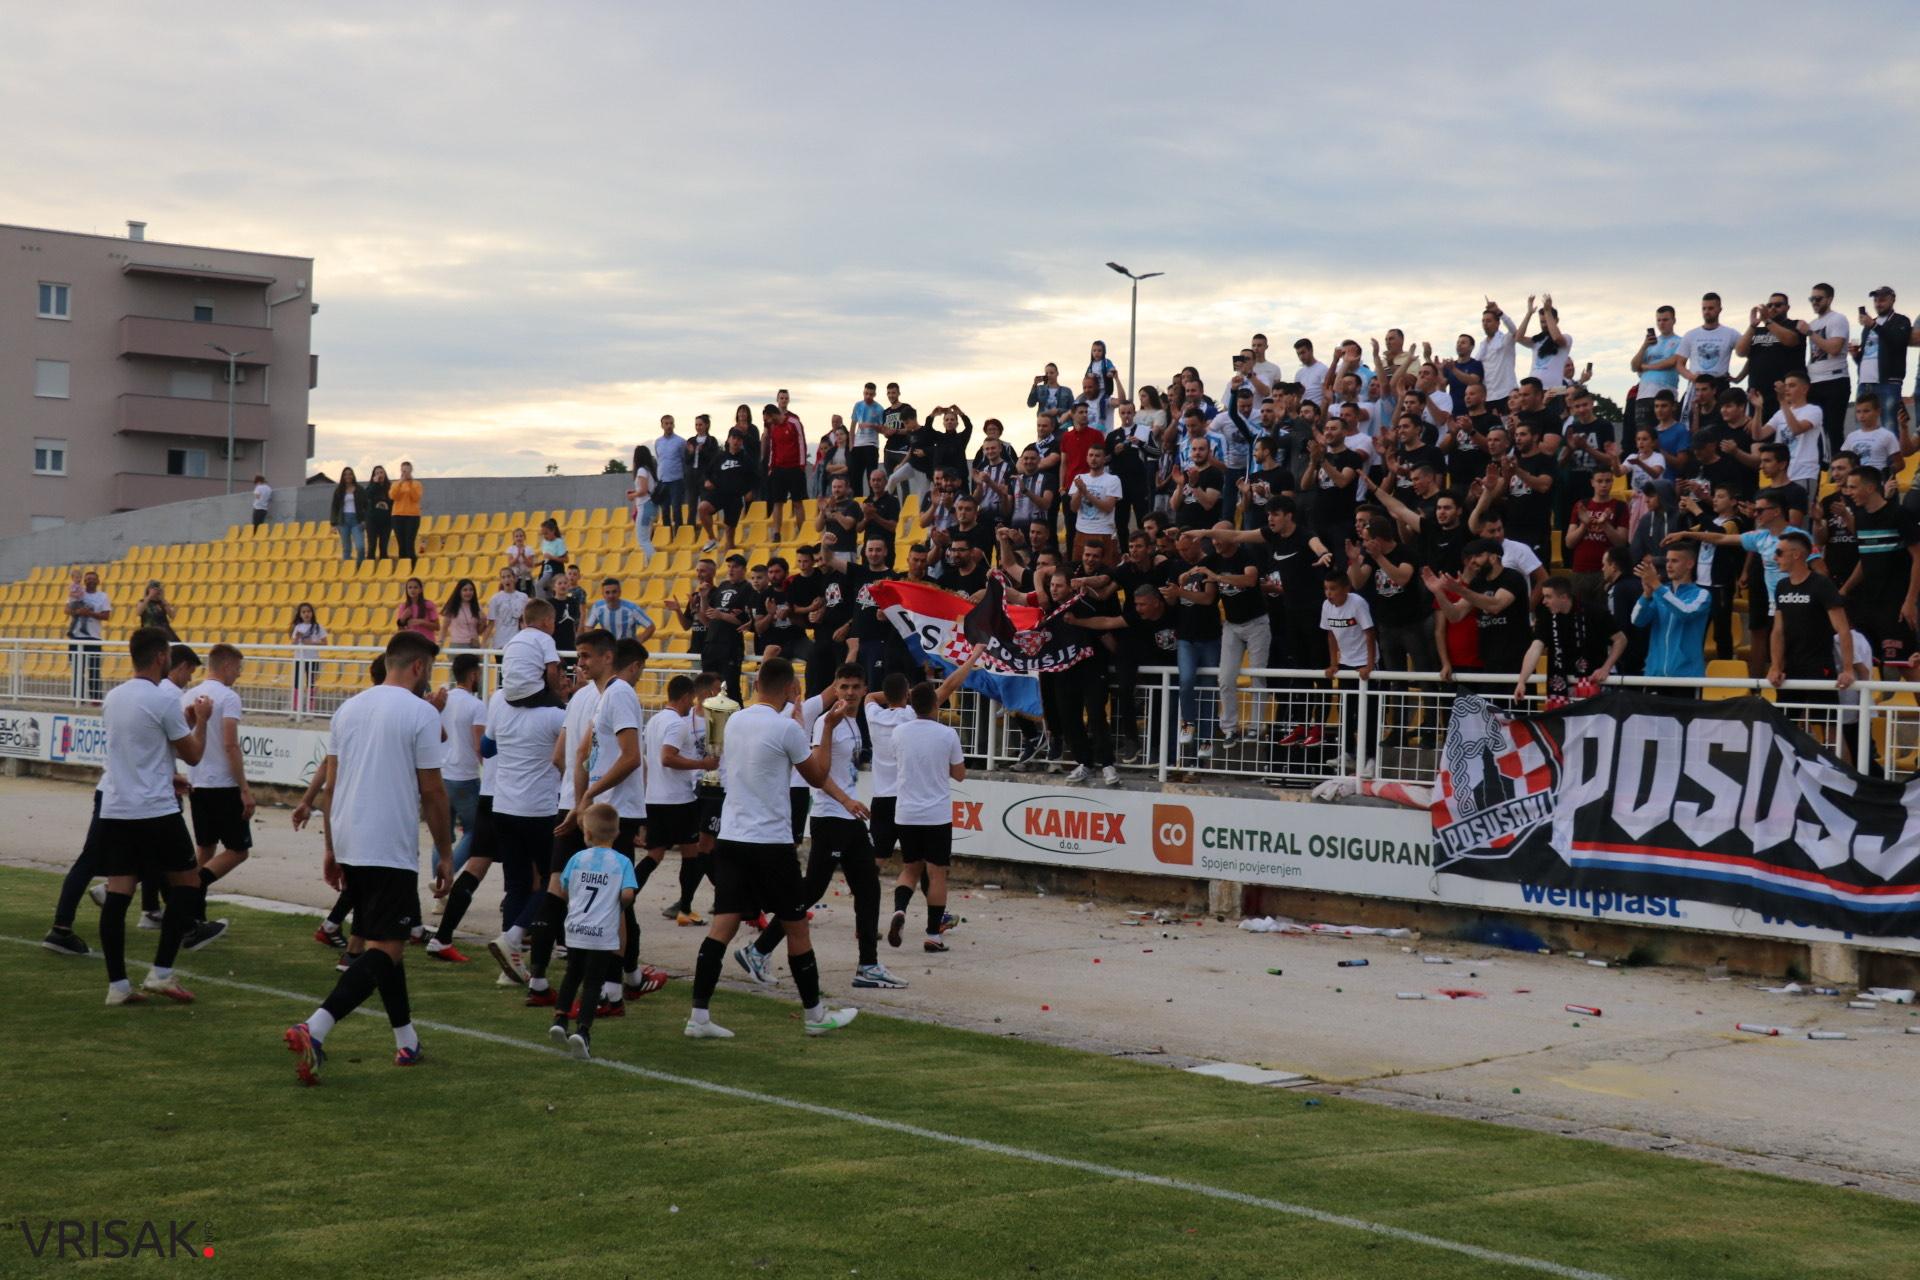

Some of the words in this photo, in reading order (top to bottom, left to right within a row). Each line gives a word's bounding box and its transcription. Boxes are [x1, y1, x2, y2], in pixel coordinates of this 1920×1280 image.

[1778, 592, 1810, 604] adidas
[952, 801, 984, 831] EX
[1025, 807, 1127, 844] KAMEX
[1059, 839, 1081, 851] d.o.o.
[1159, 822, 1187, 847] CO
[1202, 826, 1302, 855] CENTRAL
[1308, 834, 1432, 868] OSIGURAN
[1201, 855, 1238, 873] Spojeni
[1239, 861, 1302, 878] povjerenjem
[584, 885, 599, 914] 7
[1519, 881, 1681, 919] weltplast
